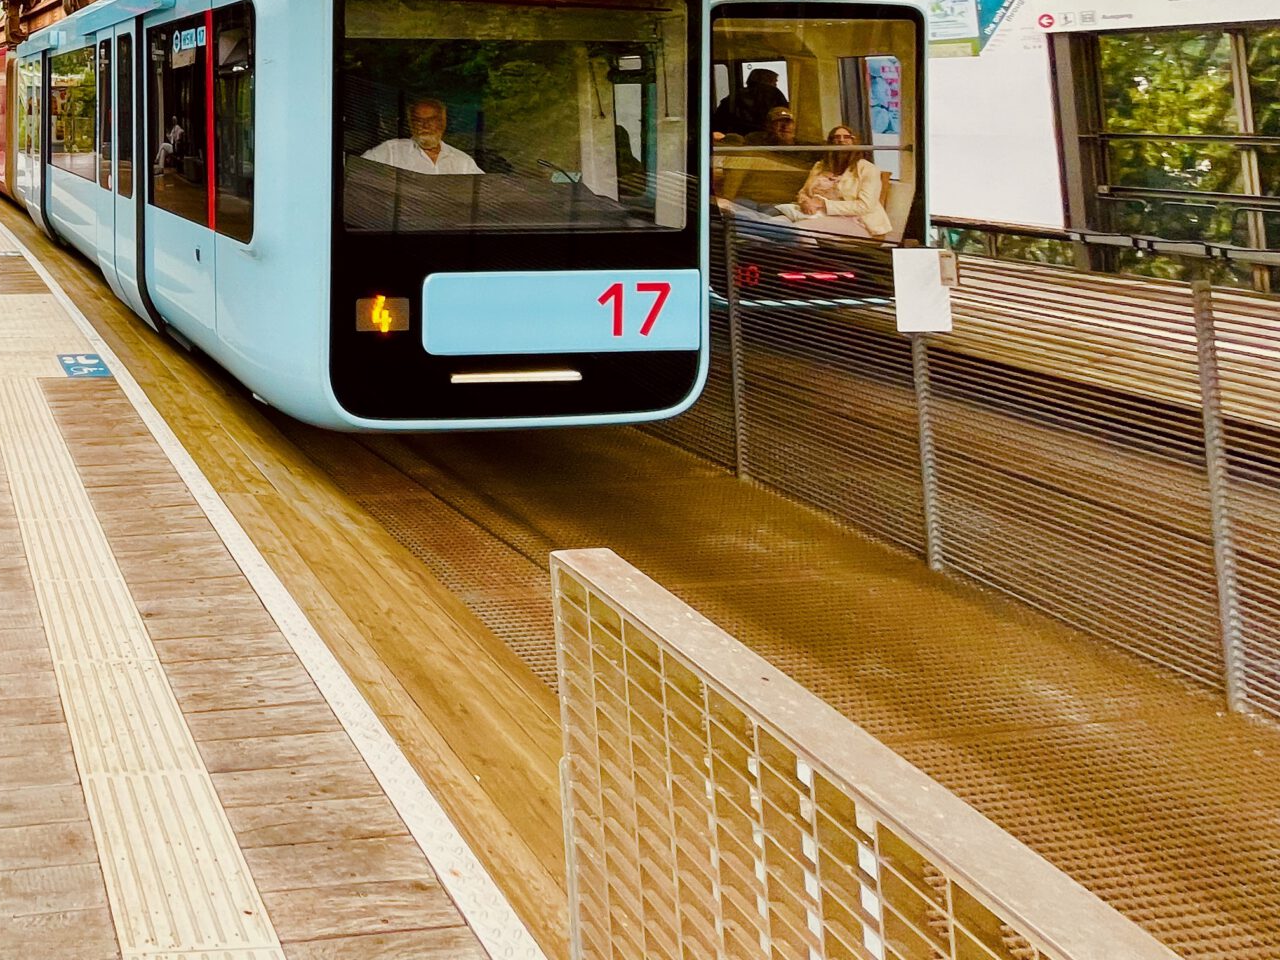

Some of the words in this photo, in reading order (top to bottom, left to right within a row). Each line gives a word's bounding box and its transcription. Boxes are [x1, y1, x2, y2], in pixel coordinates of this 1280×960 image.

[983, 23, 997, 35] the
[992, 8, 1007, 23] only
[597, 282, 671, 337] 17
